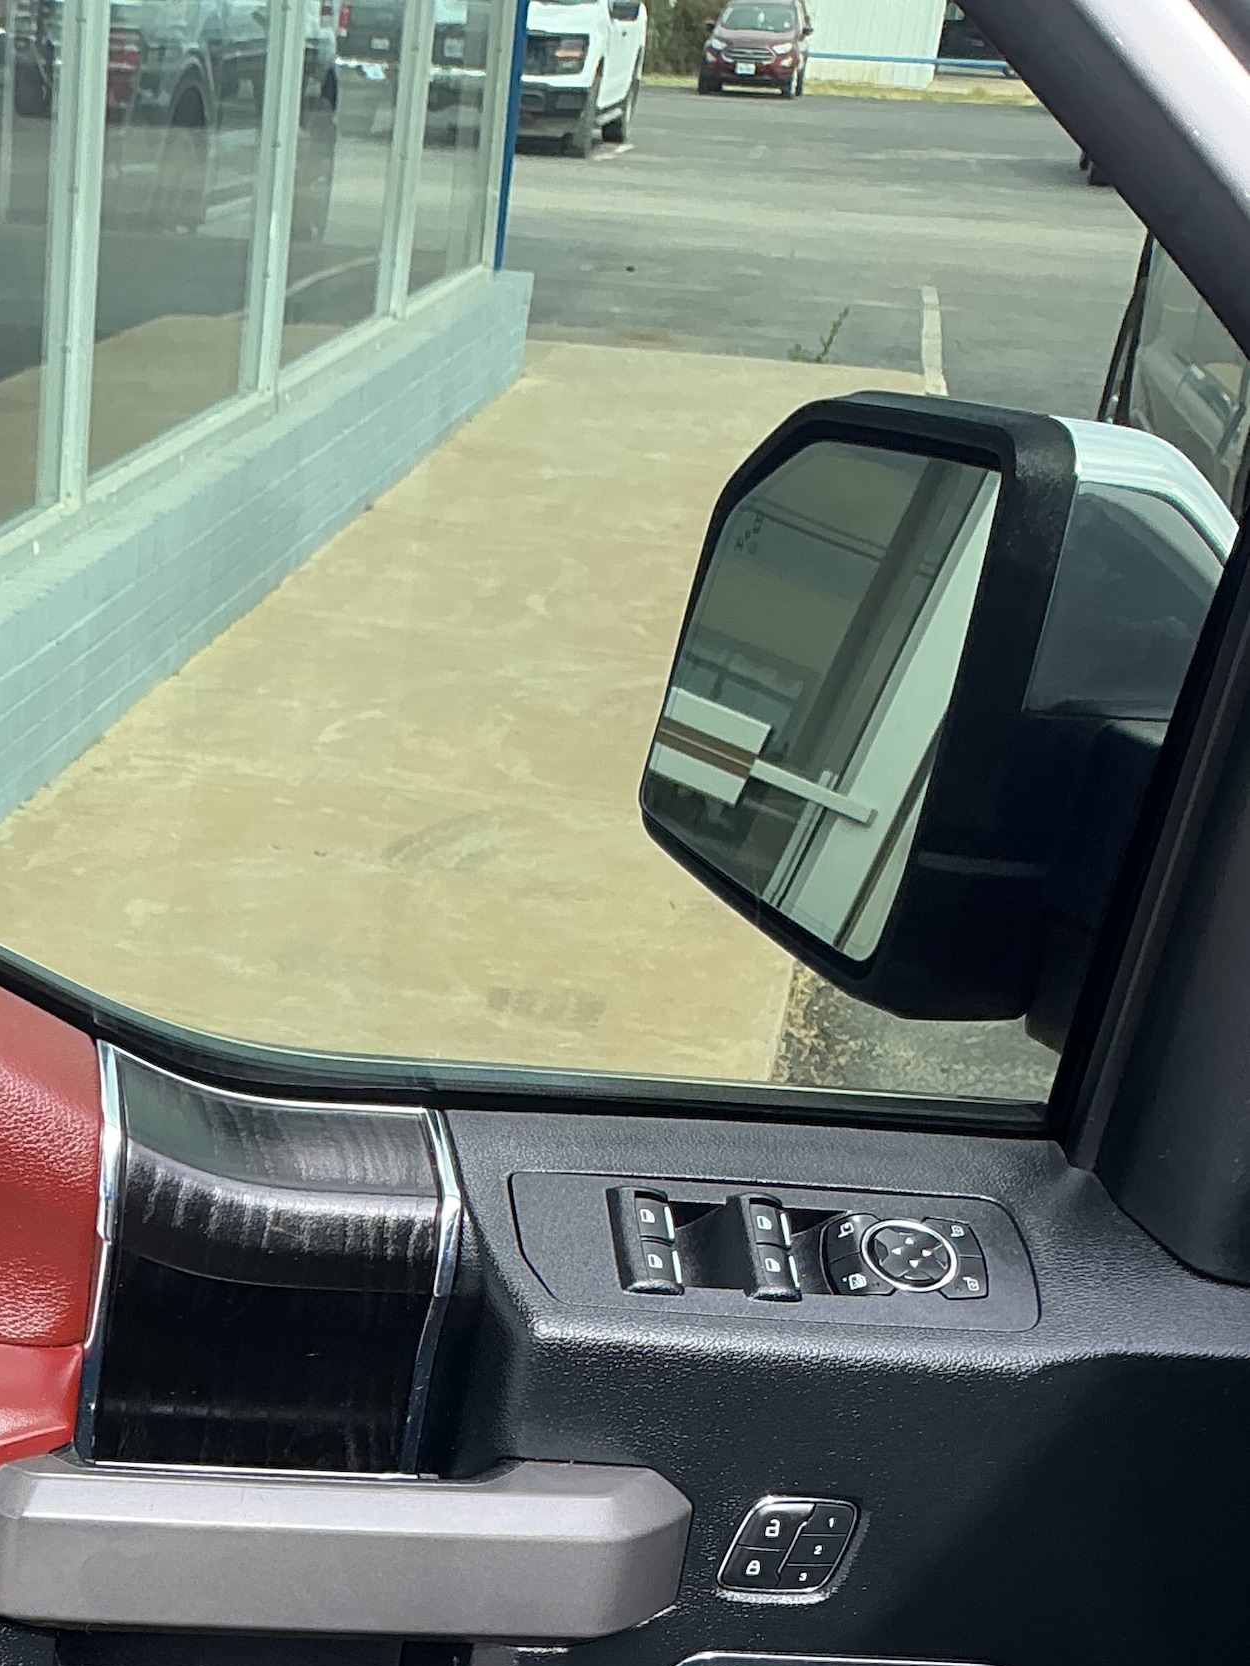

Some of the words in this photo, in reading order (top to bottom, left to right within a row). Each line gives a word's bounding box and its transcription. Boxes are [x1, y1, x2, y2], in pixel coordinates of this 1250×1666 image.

[829, 1517, 835, 1528] 1
[814, 1545, 823, 1555] 2
[799, 1573, 808, 1581] 3
